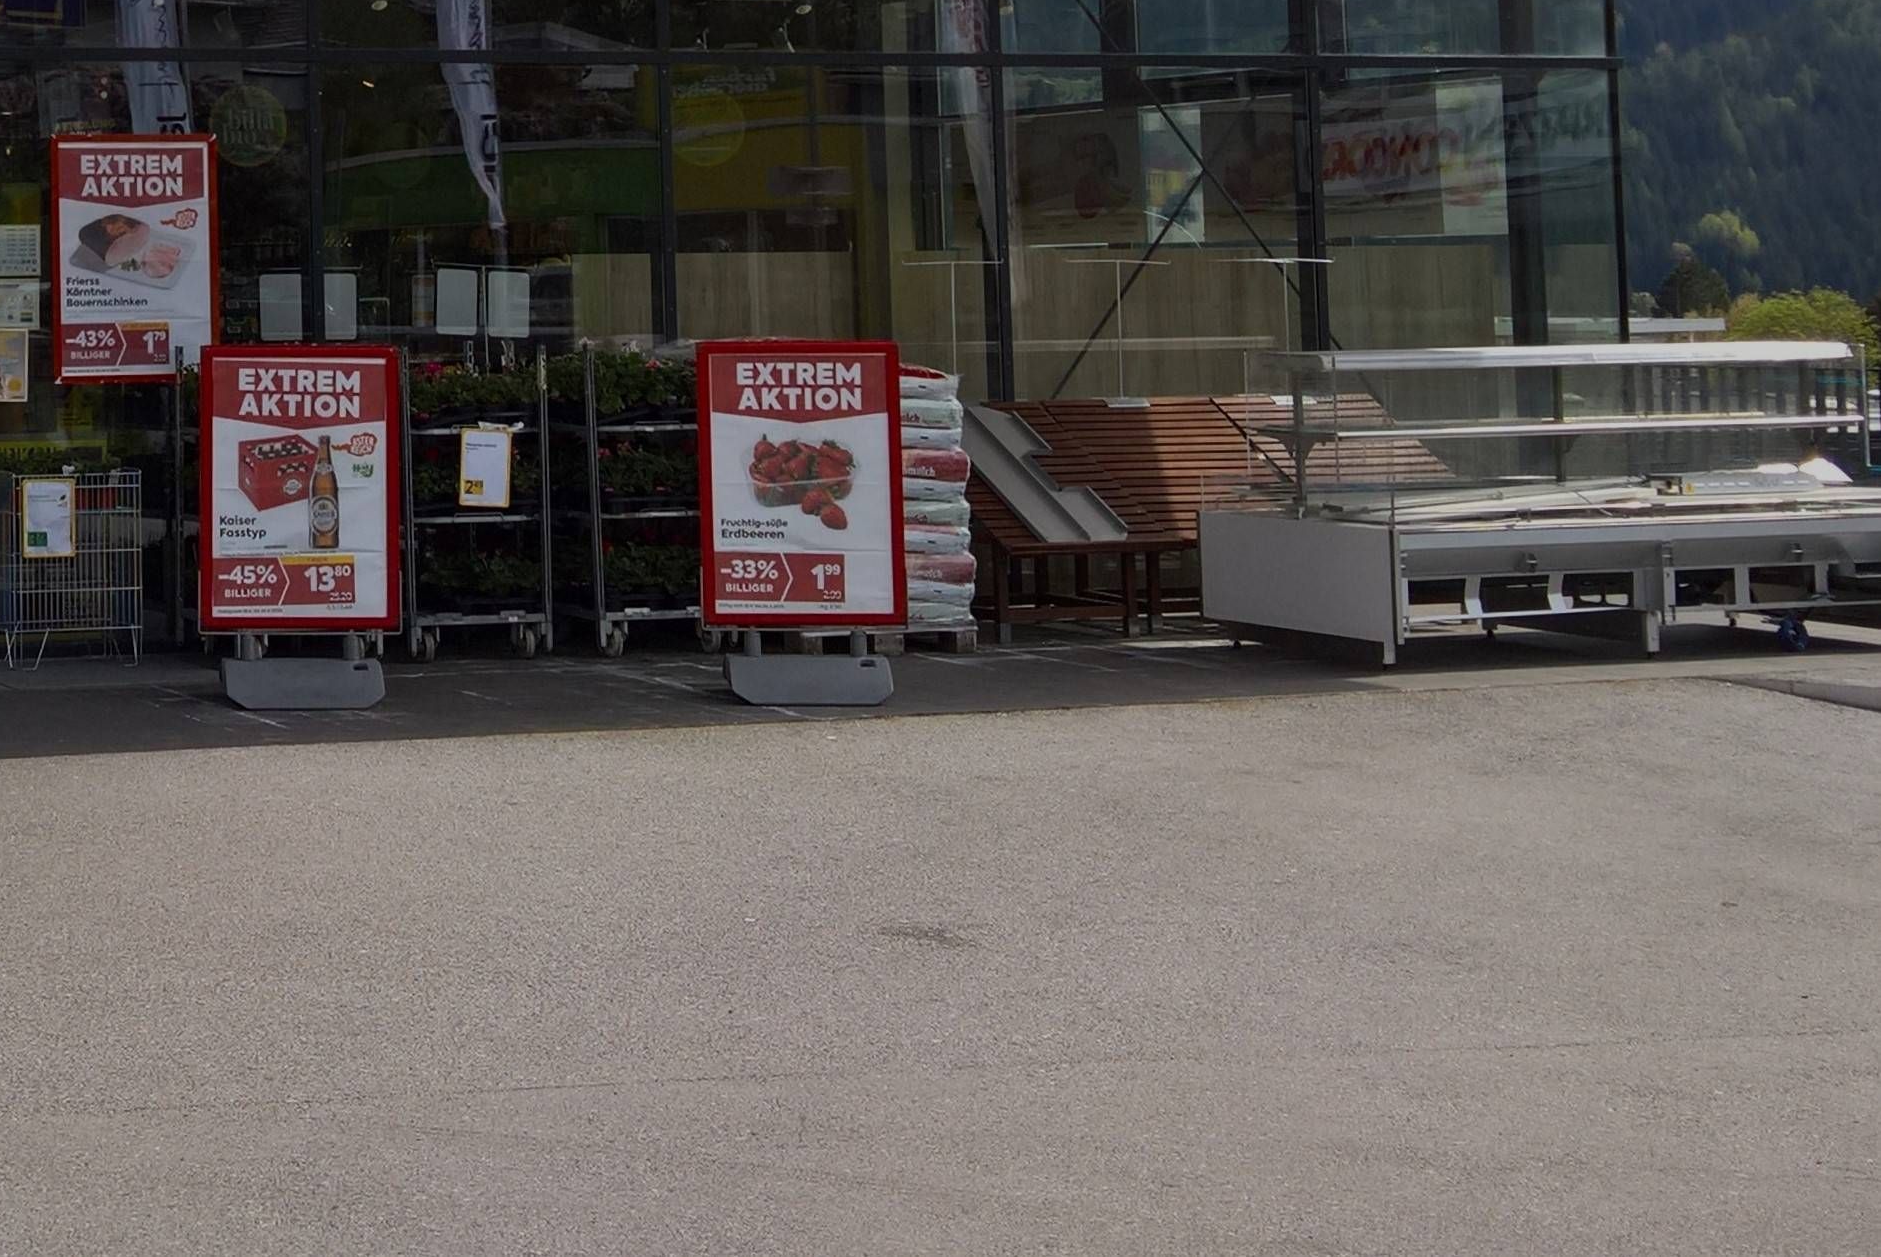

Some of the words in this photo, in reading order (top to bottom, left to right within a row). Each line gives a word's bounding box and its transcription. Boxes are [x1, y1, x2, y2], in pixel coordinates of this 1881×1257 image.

[79, 154, 183, 176] EXTREM
[80, 176, 183, 197] AKTION
[66, 277, 100, 286] Frierss
[66, 287, 113, 297] Kärntner
[66, 297, 148, 308] Bauernschinken
[70, 350, 111, 360] BILLIGER
[736, 362, 862, 386] EXTREM
[238, 367, 361, 393] EXTREM
[737, 387, 863, 411] AKTION
[238, 393, 361, 418] AKTION
[219, 515, 257, 526] Kaiser
[219, 528, 267, 539] Fasstyp
[721, 529, 785, 539] Erdbeeren
[224, 588, 271, 598] BILLIGER
[725, 583, 774, 593] BILLIGER
